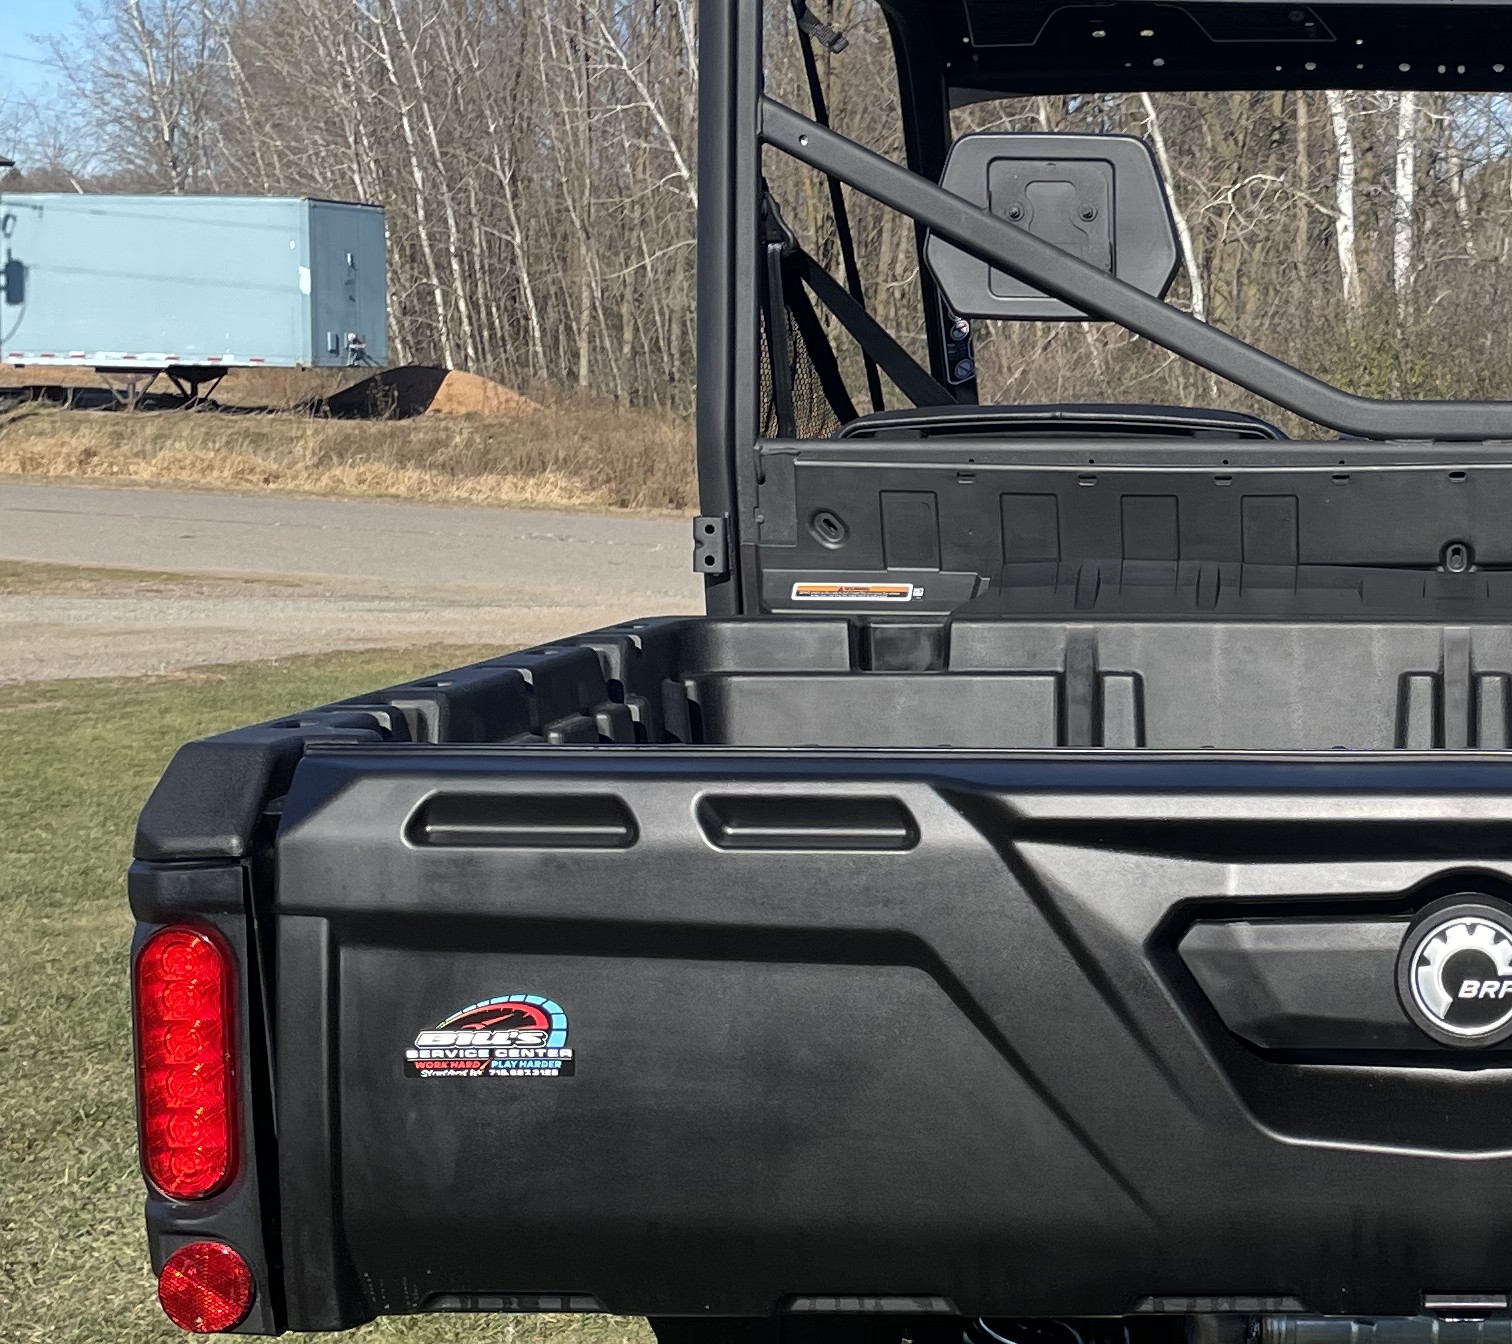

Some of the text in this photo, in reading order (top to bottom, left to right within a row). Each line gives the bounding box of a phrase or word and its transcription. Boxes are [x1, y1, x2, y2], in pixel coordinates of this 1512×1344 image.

[405, 1048, 573, 1058] SERVICE CENTER
[415, 1060, 562, 1069] WORK HARD PLAY HARDER
